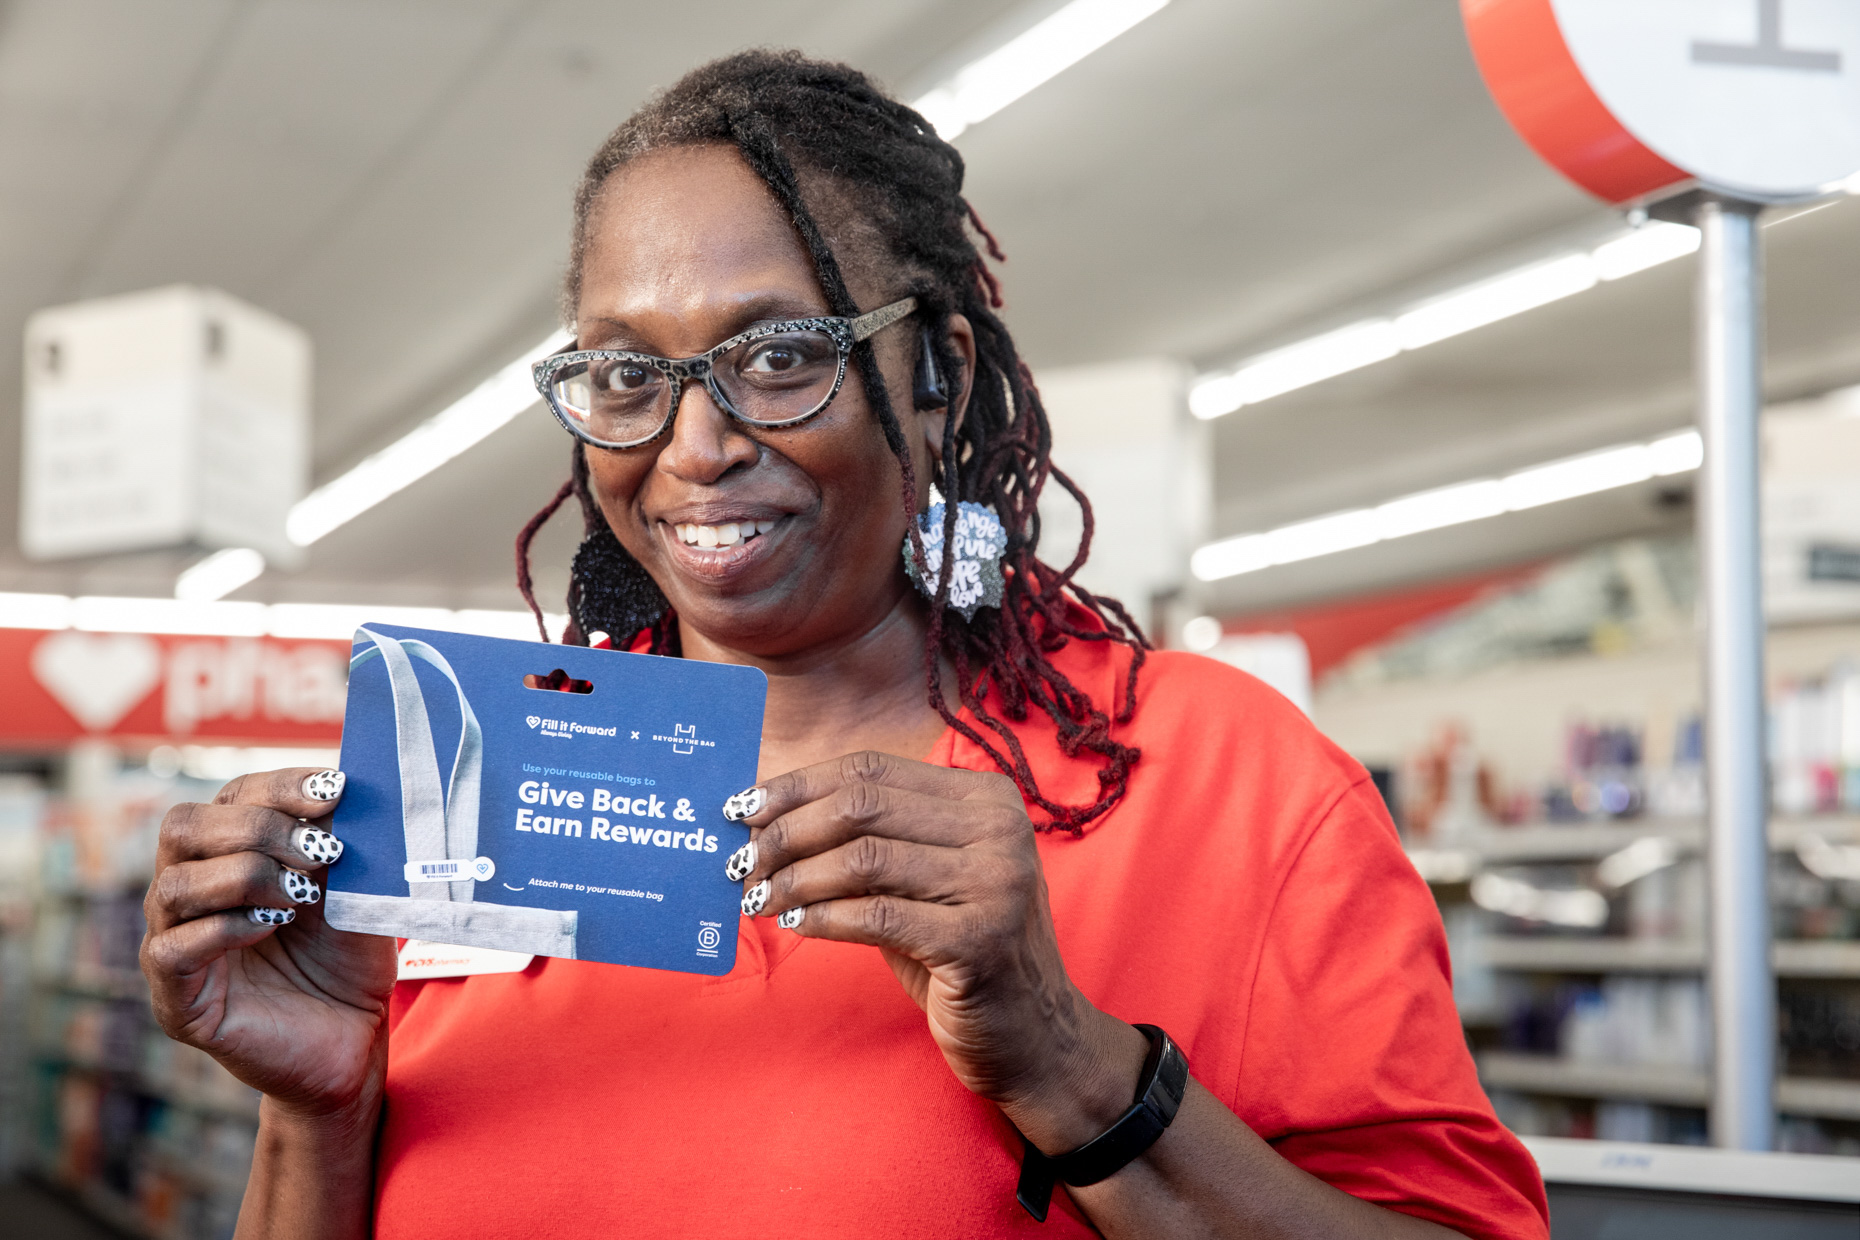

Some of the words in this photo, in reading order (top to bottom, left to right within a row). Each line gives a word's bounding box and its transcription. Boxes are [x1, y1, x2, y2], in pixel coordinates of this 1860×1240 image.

[541, 719, 558, 730] Fill
[560, 720, 568, 731] it
[570, 722, 617, 737] Forward
[652, 734, 684, 744] BEYOND
[685, 738, 699, 746] THE
[700, 740, 716, 748] BAG
[522, 763, 542, 773] Use
[543, 766, 568, 776] your
[568, 769, 614, 782] reusable
[616, 774, 642, 786] bags
[644, 777, 656, 786] to
[518, 780, 585, 809] Give
[592, 788, 666, 819] Back
[672, 798, 696, 822] &
[515, 808, 583, 838] Earn
[590, 816, 719, 853] Rewards
[528, 878, 559, 888] Attach
[559, 882, 574, 890] me
[575, 883, 585, 891] to
[586, 885, 607, 894] your
[607, 887, 645, 898] reusable
[645, 890, 664, 902] bag
[703, 931, 715, 945] B
